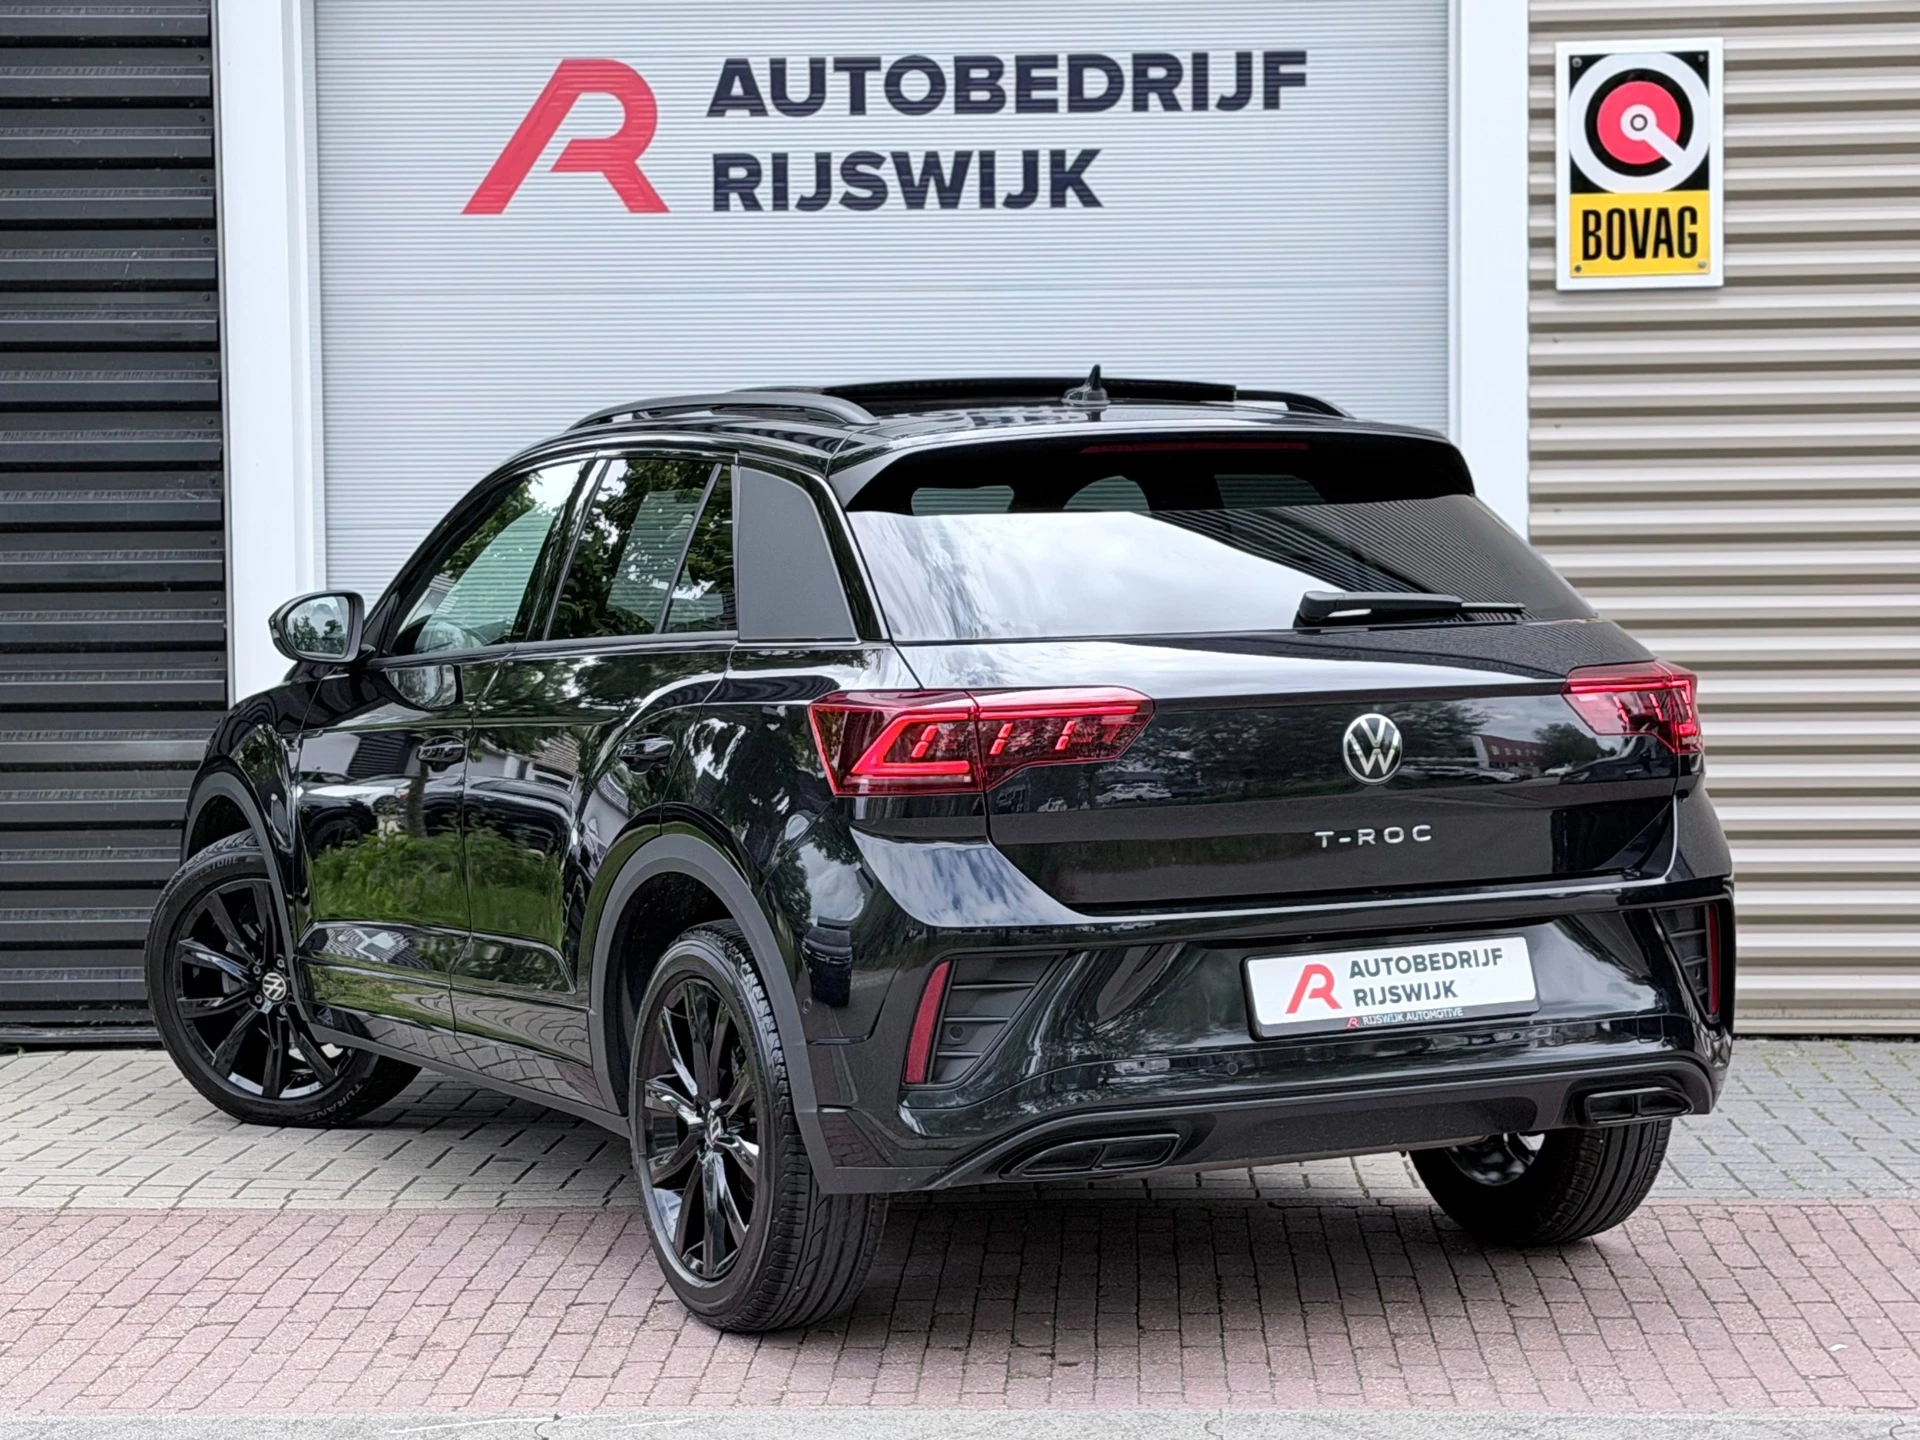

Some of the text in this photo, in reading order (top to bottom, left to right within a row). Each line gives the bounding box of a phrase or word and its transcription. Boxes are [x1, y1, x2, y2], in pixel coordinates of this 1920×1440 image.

[706, 50, 1308, 119] AUTOBEDRIJF
[712, 149, 1103, 212] RIJSWIJK
[1582, 206, 1698, 261] BOVAG
[1314, 824, 1432, 848] T-ROC
[1348, 947, 1503, 979] AUTOBEDRIJF
[1352, 979, 1459, 1008] RIJSWIJK
[1362, 1011, 1405, 1026] RIJSWIJK
[1405, 1007, 1464, 1022] AUTOMOTIVE
